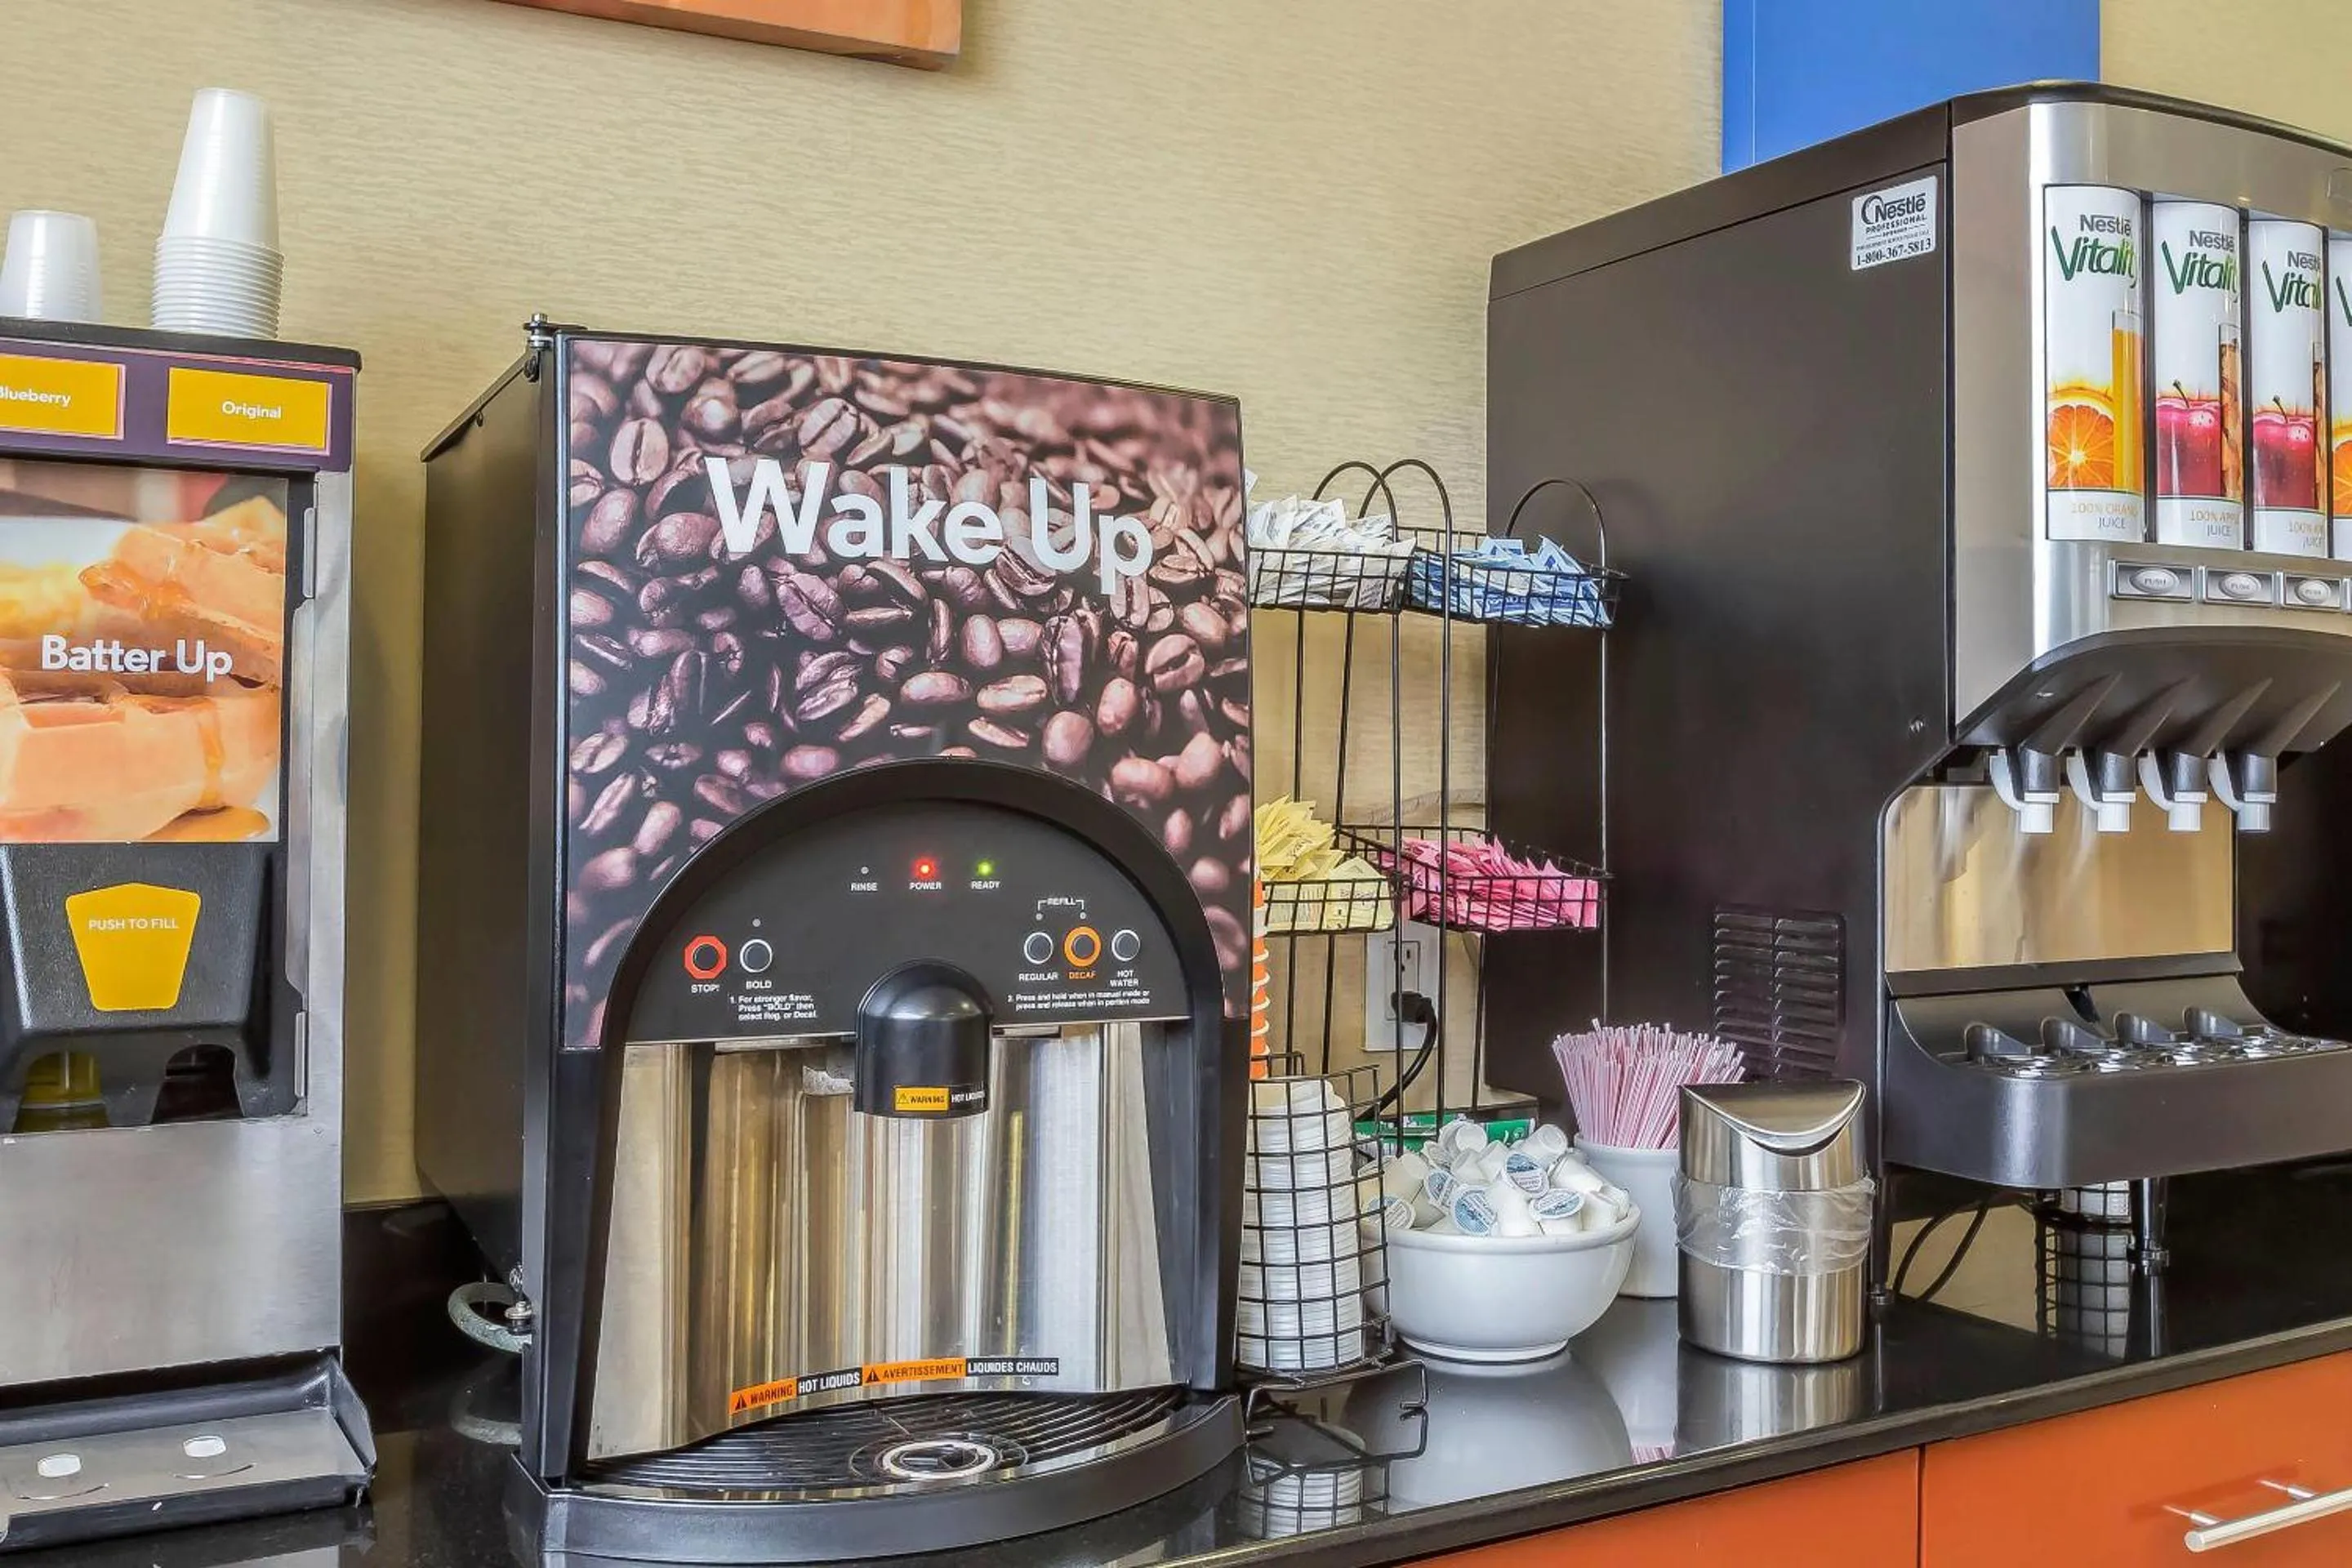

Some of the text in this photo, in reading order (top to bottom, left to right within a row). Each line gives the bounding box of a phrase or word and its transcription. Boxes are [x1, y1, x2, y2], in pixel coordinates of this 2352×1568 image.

[222, 400, 282, 420] Original
[705, 457, 1153, 595] Wake Up
[42, 634, 234, 684] Batter Up
[850, 882, 879, 892] RINSE
[908, 881, 942, 890] POWER
[971, 880, 1000, 890] READY
[1047, 898, 1076, 906] REFILL
[88, 918, 180, 931] PUSH TO FILL
[1018, 972, 1058, 982] REGULAR
[1068, 972, 1097, 980] DECAF
[1117, 969, 1134, 978] HOT
[746, 980, 773, 990] BOLD
[1109, 979, 1139, 987] WATER
[1037, 993, 1051, 1001] and
[1068, 991, 1087, 1000] when
[910, 1094, 946, 1104] WARNING
[951, 1094, 964, 1103] HOT
[750, 1361, 1058, 1405] WARNING HOT LIQUIDS AVERTISSEMENT LIQUIDES CHAUDS
